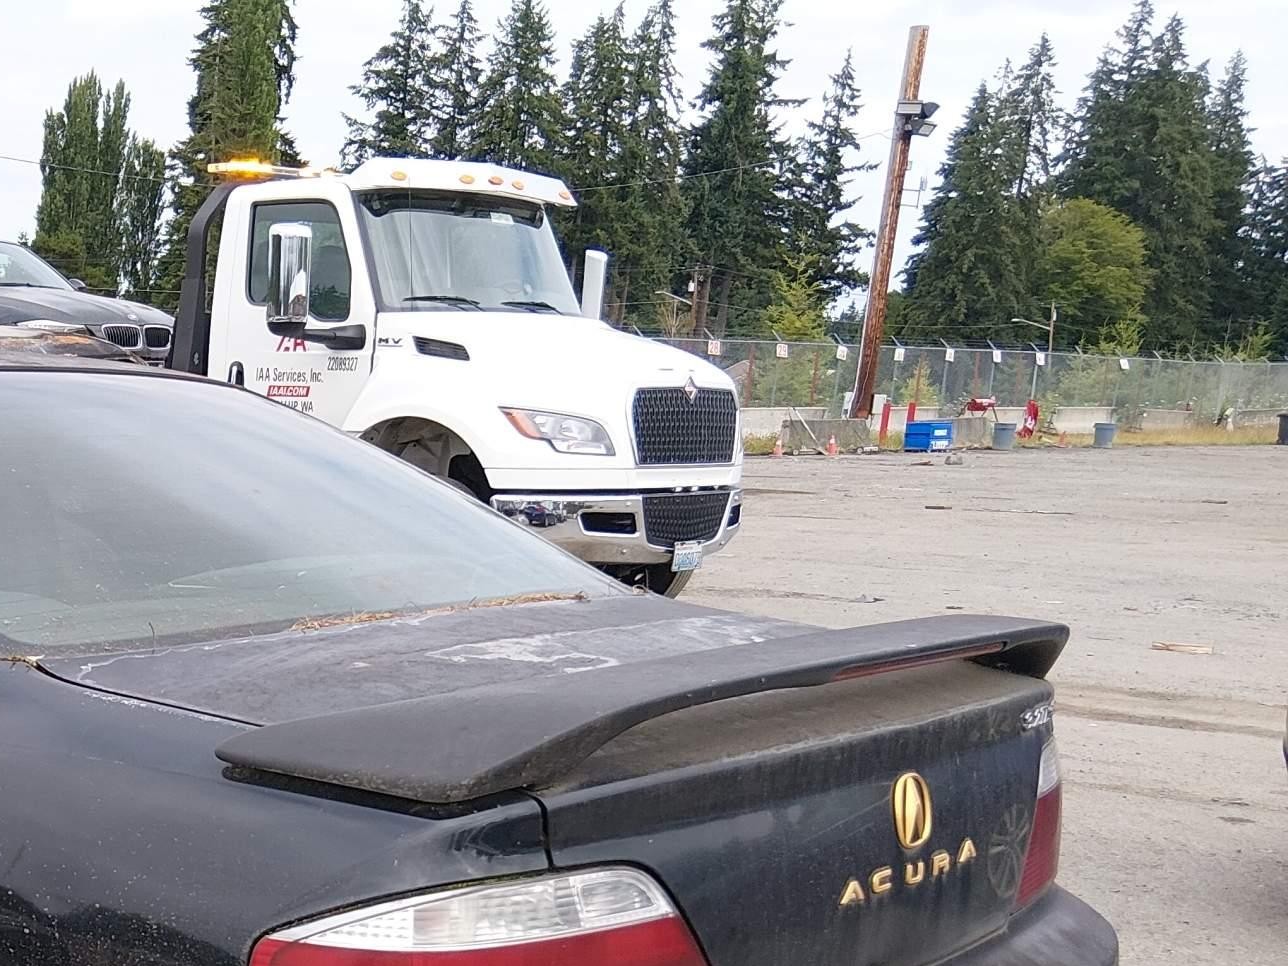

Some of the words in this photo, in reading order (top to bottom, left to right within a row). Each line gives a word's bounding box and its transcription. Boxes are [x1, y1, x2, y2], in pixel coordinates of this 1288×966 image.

[709, 341, 719, 354] 28
[327, 356, 358, 372] 22089327
[256, 367, 270, 382] IAA
[272, 367, 308, 384] Services,
[310, 368, 324, 383] Inc.
[300, 400, 313, 413] WA
[838, 837, 977, 907] ACURA
